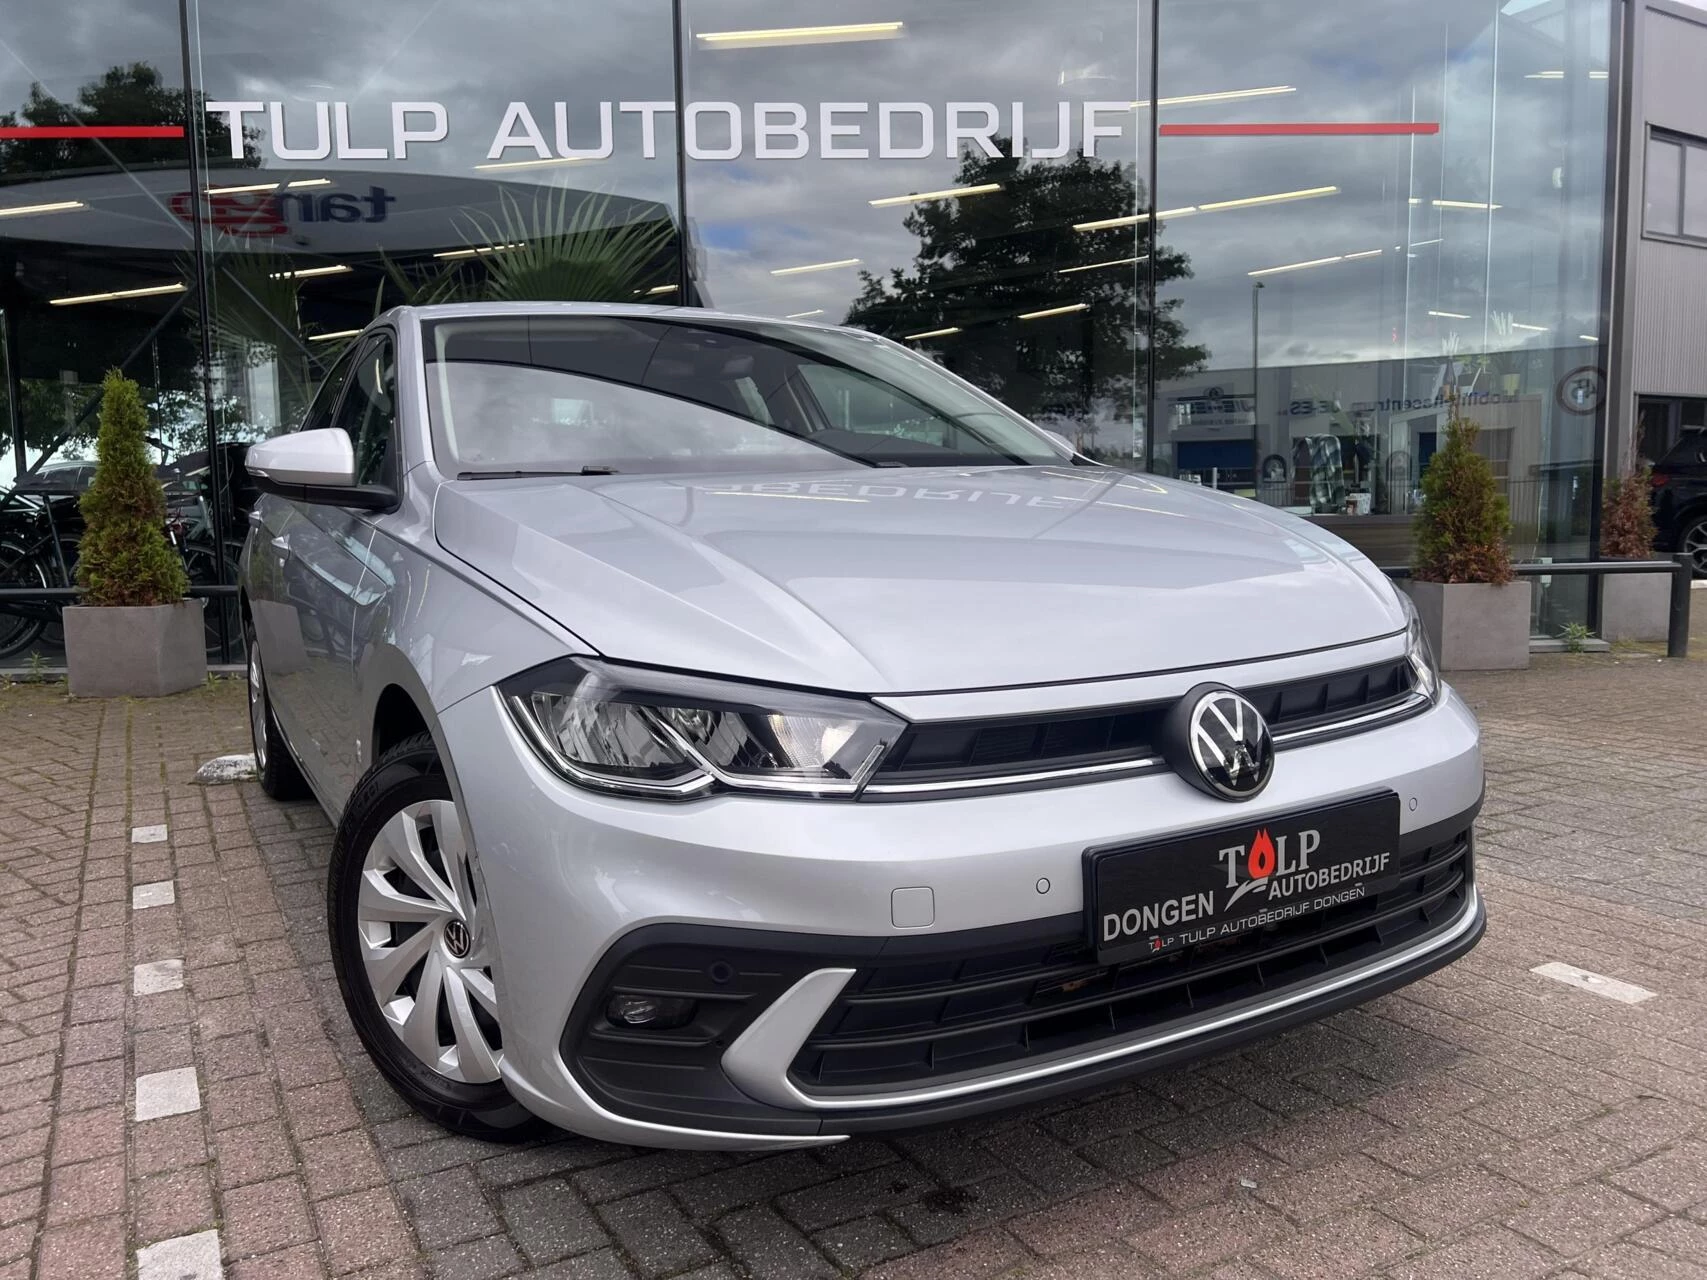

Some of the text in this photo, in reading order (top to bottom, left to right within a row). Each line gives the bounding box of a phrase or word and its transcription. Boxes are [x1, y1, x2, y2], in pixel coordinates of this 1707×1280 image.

[205, 101, 1131, 160] TULP AUTOBEDRIJF
[1268, 852, 1391, 901] AUTOBEDRIJF
[1103, 890, 1214, 942] DONGEN
[1179, 927, 1216, 946] TULP
[1220, 902, 1310, 936] AUTOBEDRIJF
[1314, 886, 1365, 911] DONGEN
